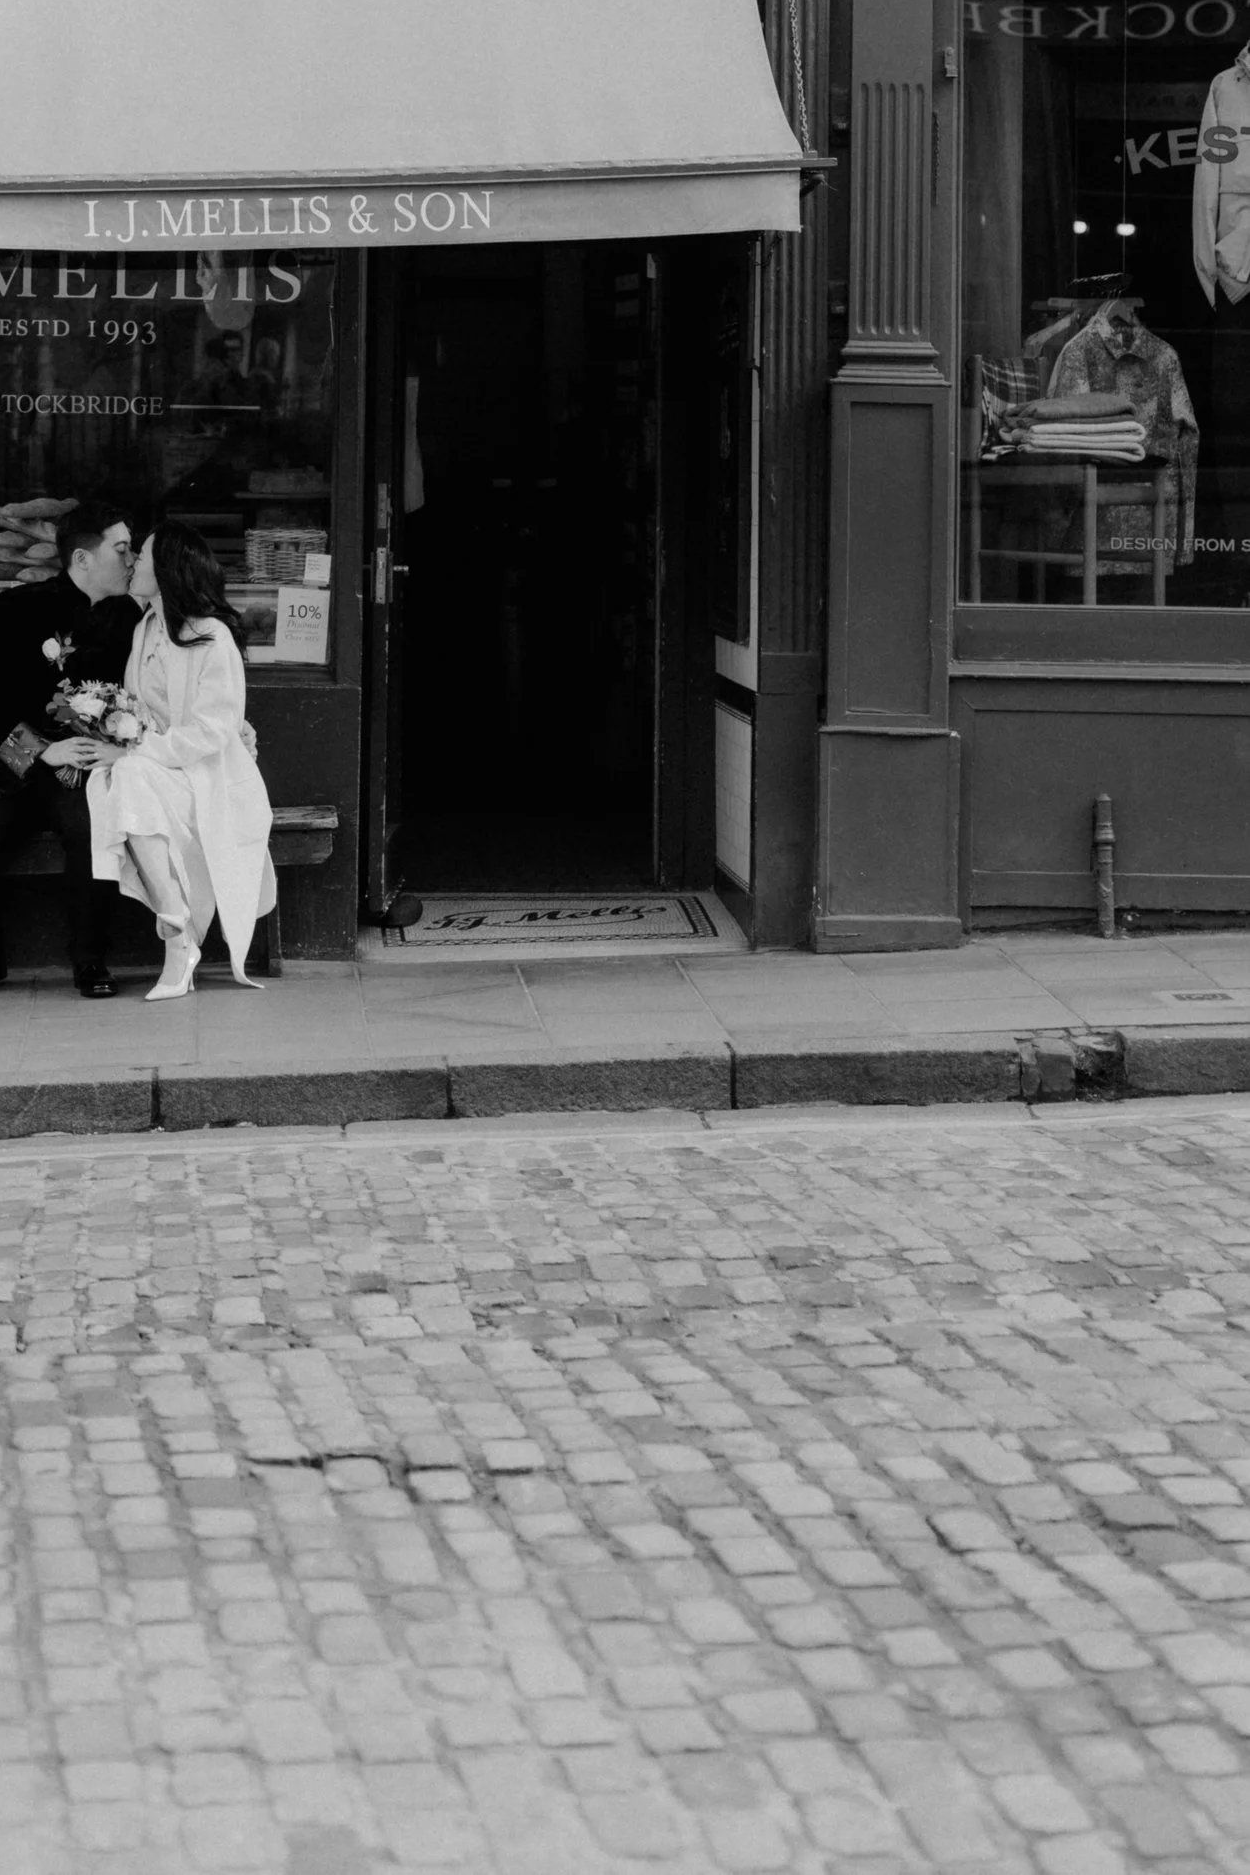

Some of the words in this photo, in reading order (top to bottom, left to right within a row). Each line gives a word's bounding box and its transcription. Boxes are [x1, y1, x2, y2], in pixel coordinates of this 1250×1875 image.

[156, 195, 332, 238] MELLIS
[347, 194, 379, 235] &
[393, 190, 494, 233] SON
[87, 319, 158, 346] 1993
[1110, 536, 1177, 551] DESIGN
[1183, 538, 1236, 553] FROM
[287, 604, 322, 620] 10%
